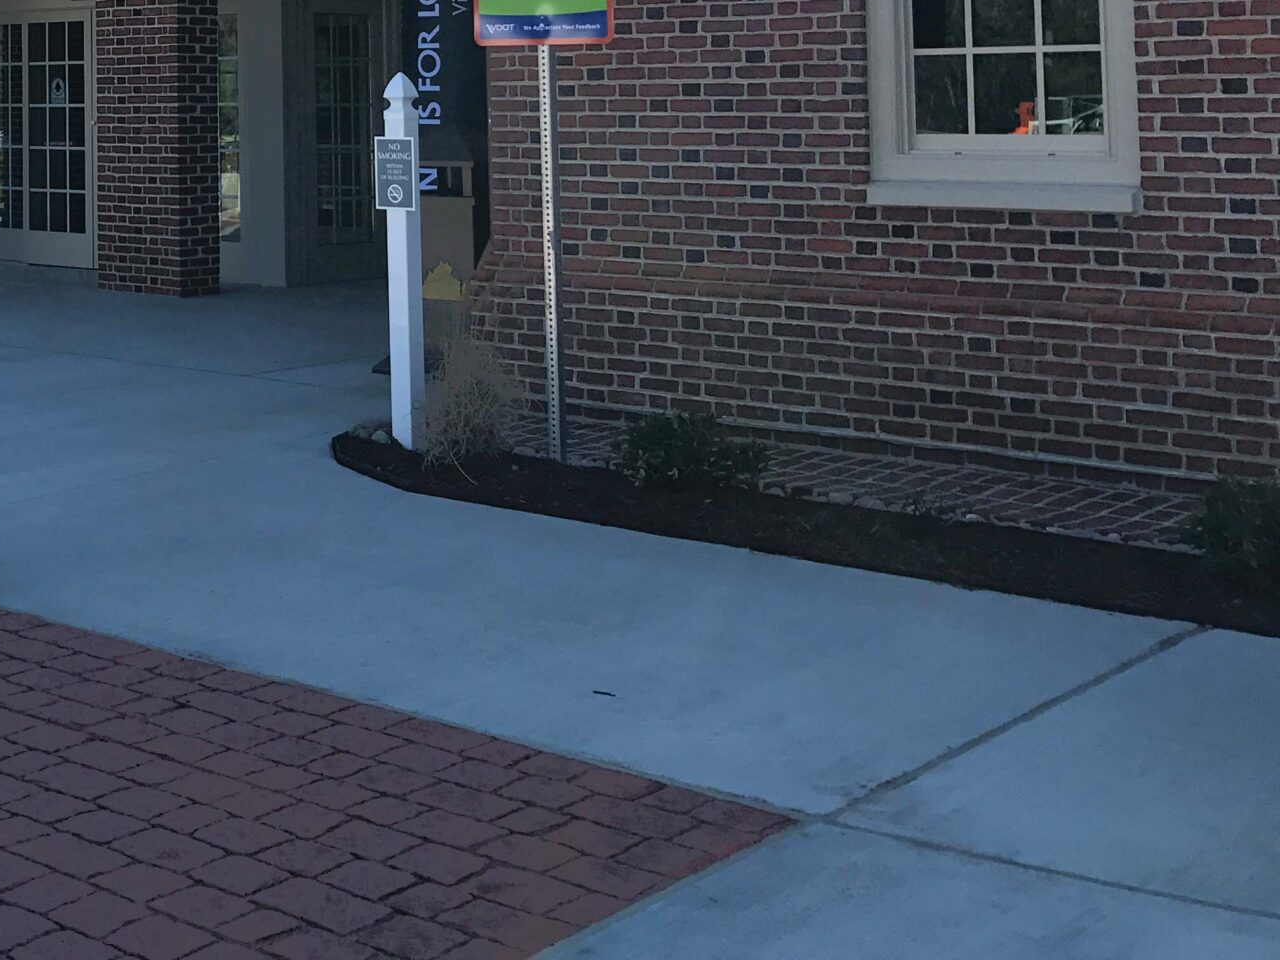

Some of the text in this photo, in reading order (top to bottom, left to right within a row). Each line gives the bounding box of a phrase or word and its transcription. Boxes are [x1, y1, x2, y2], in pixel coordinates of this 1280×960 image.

[486, 24, 515, 33] VDOT
[562, 23, 575, 31] Your
[576, 23, 600, 31] Feedback
[418, 24, 441, 92] FOR
[418, 101, 441, 125] IS
[377, 152, 412, 160] SMOKING
